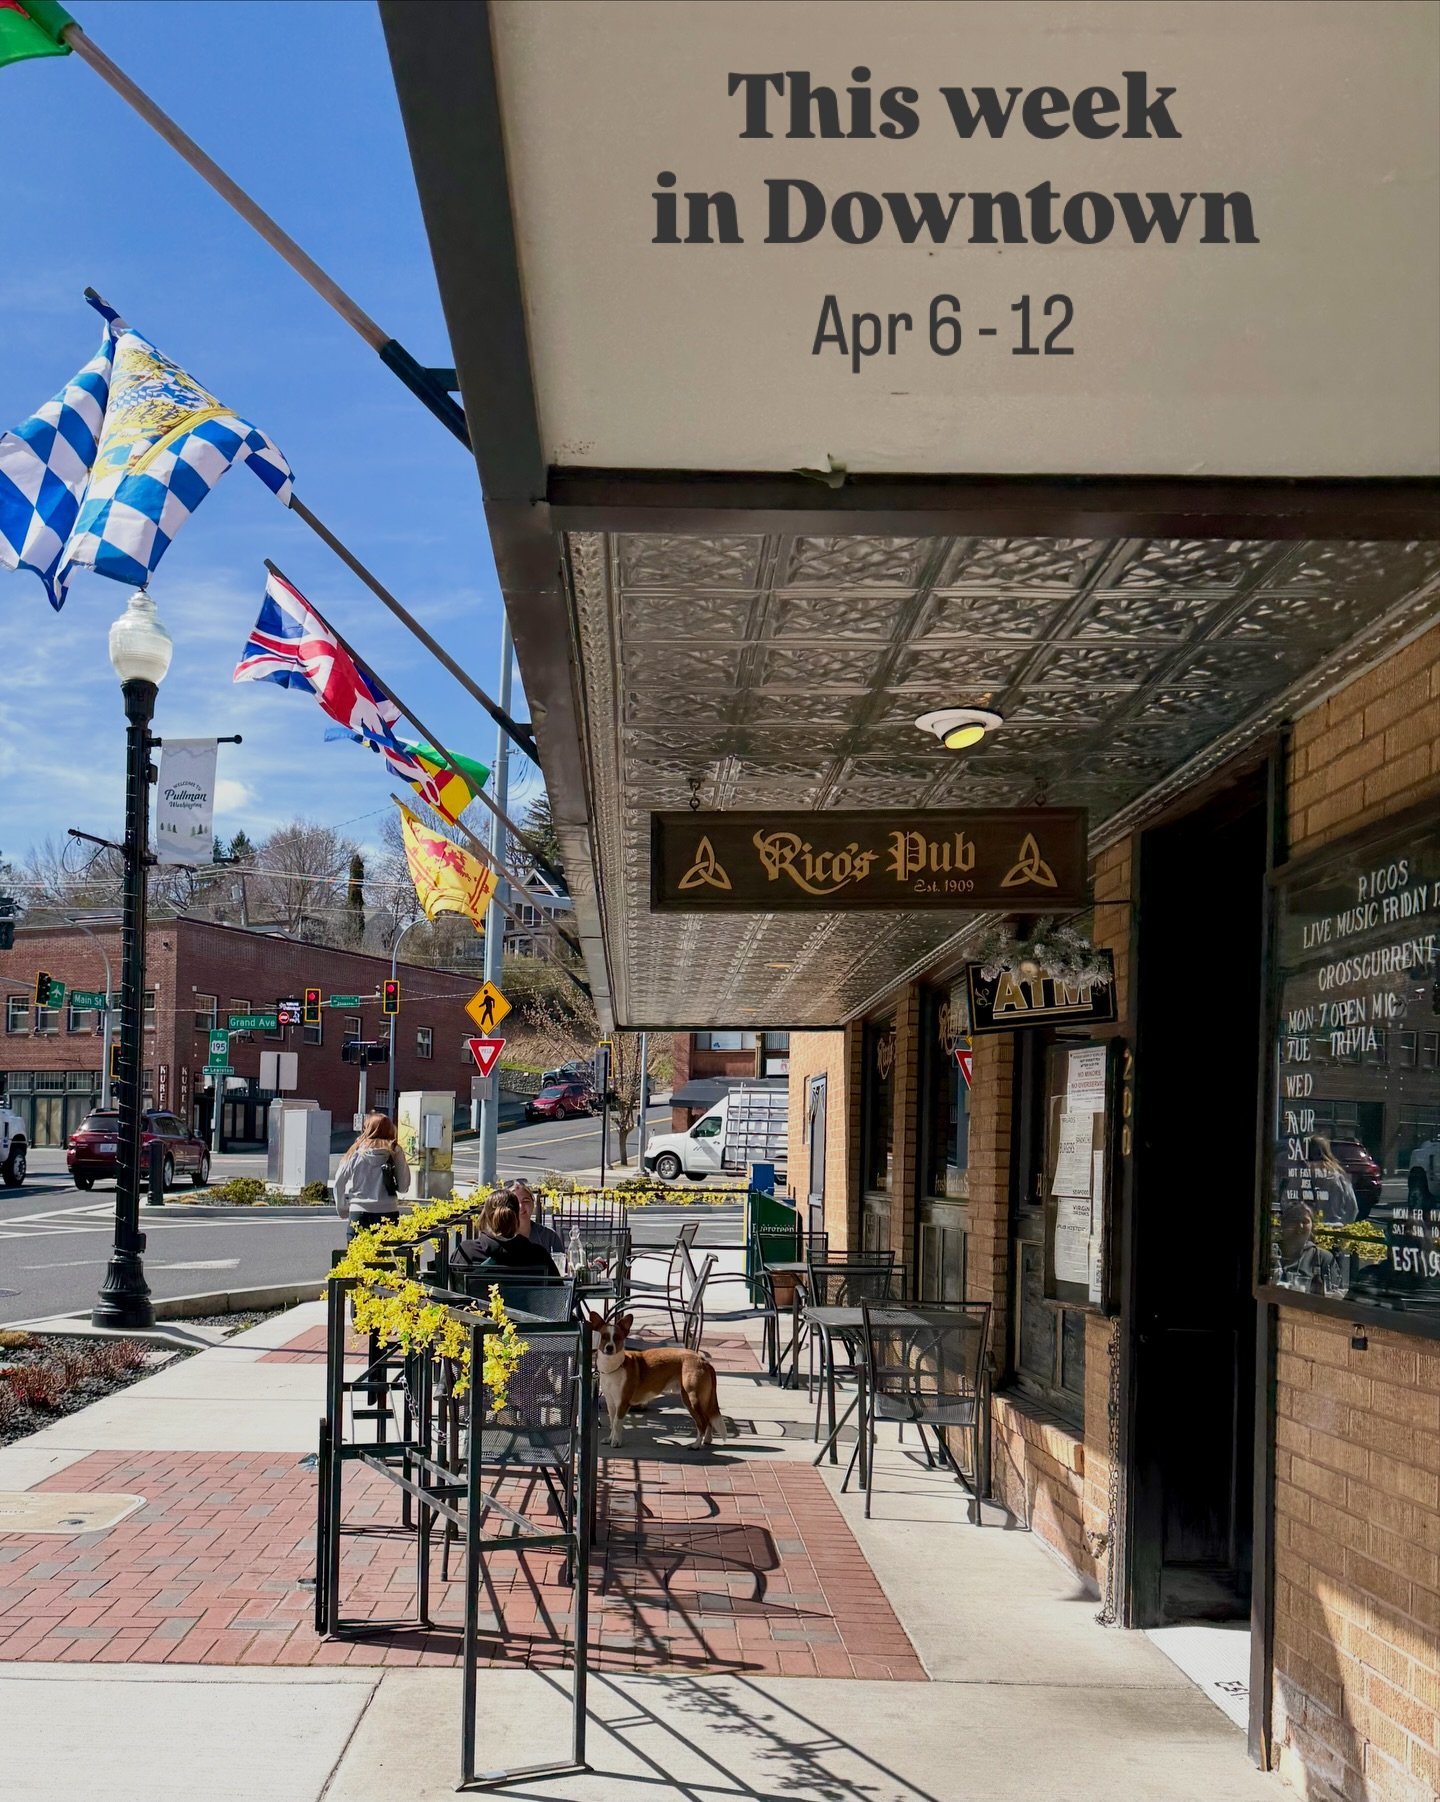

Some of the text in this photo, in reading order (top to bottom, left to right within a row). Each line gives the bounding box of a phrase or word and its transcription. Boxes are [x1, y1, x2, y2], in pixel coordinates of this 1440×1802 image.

[164, 788, 207, 802] Pullman
[752, 828, 976, 896] Rico's Pub
[913, 878, 975, 894] Est. 1909
[1358, 860, 1408, 902] RICOS
[1303, 918, 1332, 949] LIVE
[1336, 902, 1378, 938] MUSIC
[1382, 885, 1427, 924] FRIDAY
[1318, 934, 1437, 991] CROSSCURRENT
[74, 994, 102, 1007] Main St
[992, 970, 1092, 1012] ATM
[230, 1017, 276, 1027] Grand Ave
[1330, 996, 1366, 1028] OPEN
[1371, 992, 1397, 1020] MIC
[212, 1042, 226, 1052] 195
[1287, 1025, 1377, 1062] TUE TRIVIA
[1286, 1073, 1313, 1098] WED
[1288, 1137, 1311, 1161] SAT
[1392, 1223, 1406, 1236] SAT
